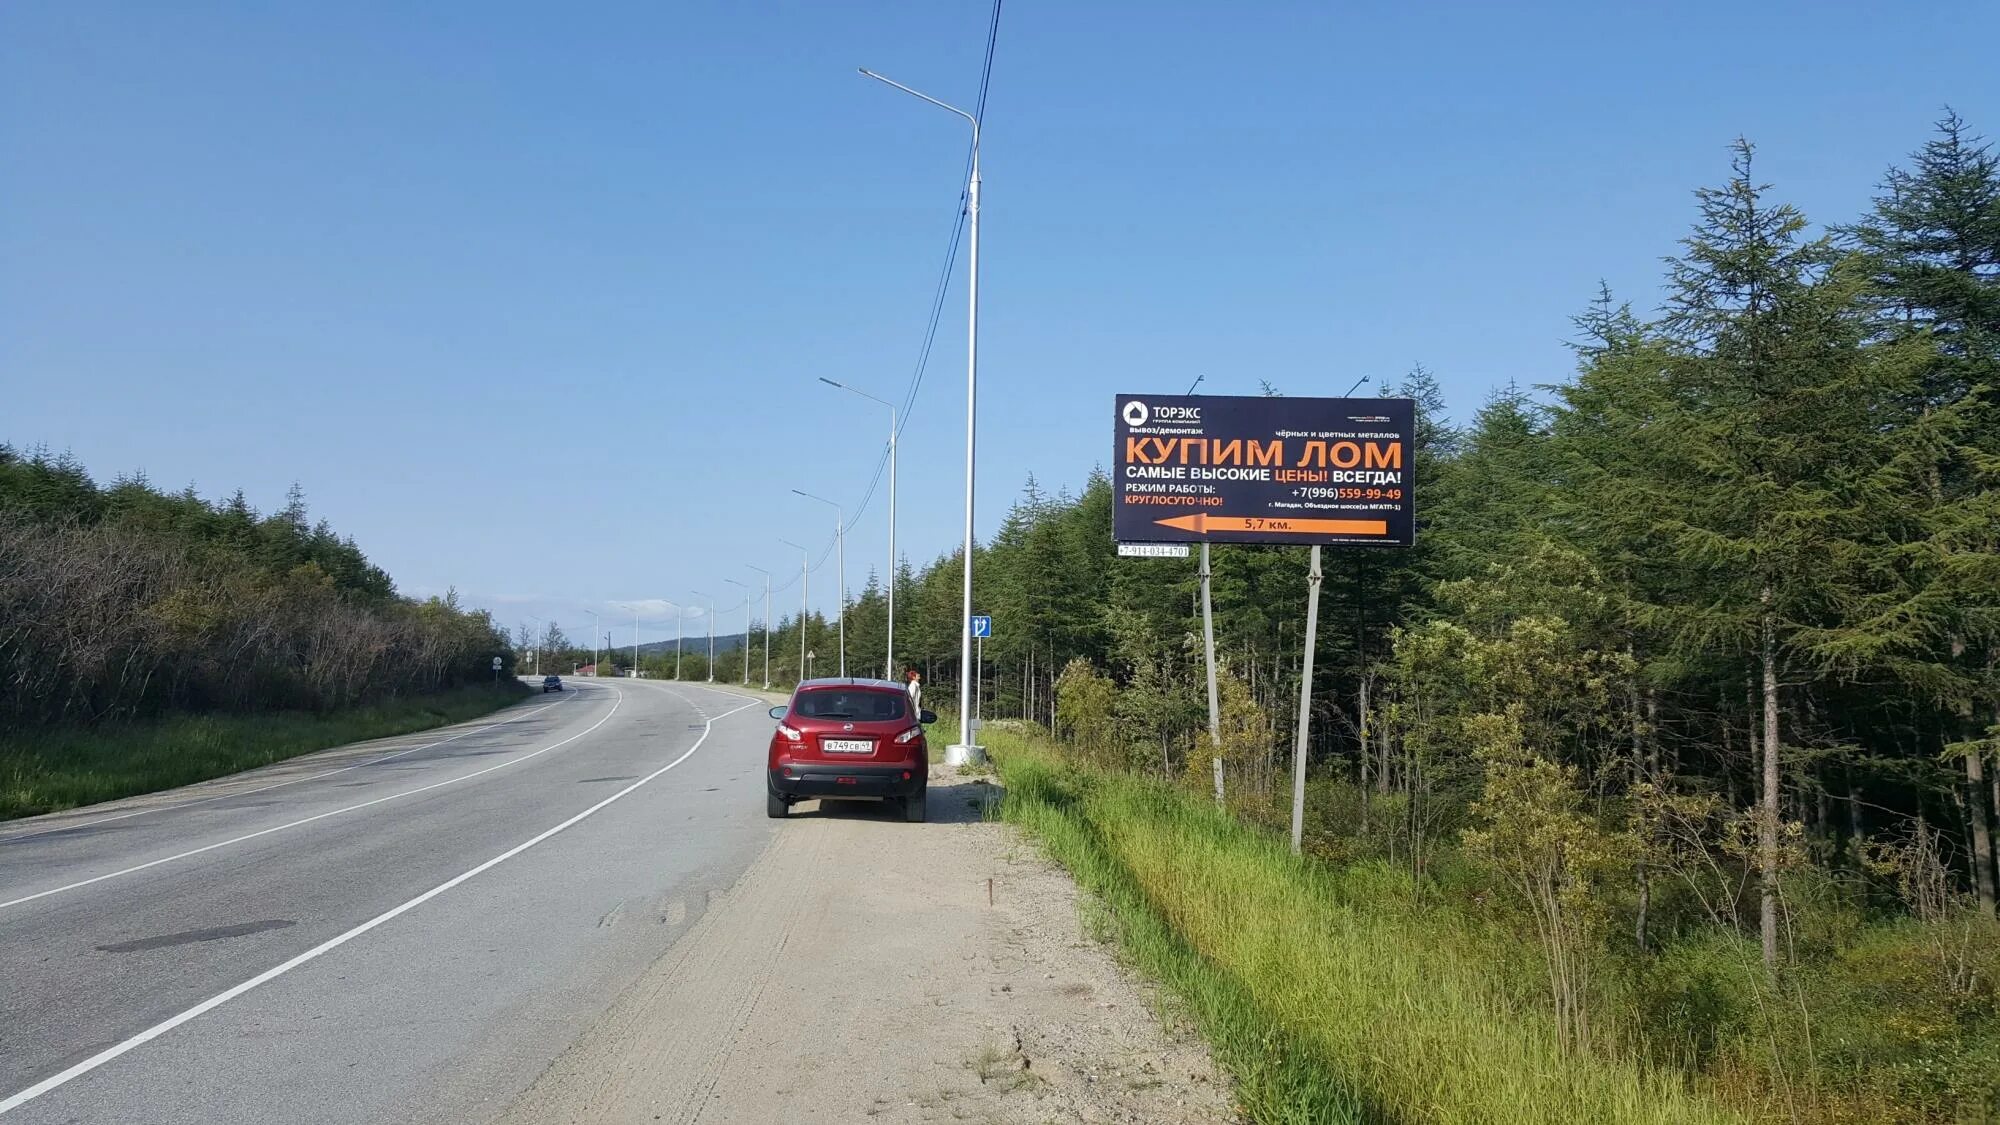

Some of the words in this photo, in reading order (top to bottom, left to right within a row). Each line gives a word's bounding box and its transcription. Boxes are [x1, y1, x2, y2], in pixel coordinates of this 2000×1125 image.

[1153, 407, 1200, 418] ТОРЭКС
[1130, 427, 1203, 435] вывоз/демонтаж
[1276, 430, 1308, 438] чёрных
[1126, 437, 1283, 466] КУПИМ
[1297, 441, 1401, 468] ЛОМ
[1126, 467, 1185, 479] САМЫЕ
[1190, 468, 1270, 480] ВЫСОКИЕ
[1276, 470, 1327, 482] ЦЕНЫ!
[1333, 471, 1401, 485] ВСЕГДА!
[1126, 484, 1165, 492] РЕЖИМ
[1169, 485, 1215, 494] РАБОТЫ:
[1292, 488, 1401, 500] +7(996)559-99-49
[1125, 496, 1223, 506] КРУГЛОСУТОЧНО!
[1244, 519, 1264, 530] 5,7
[1269, 522, 1291, 530] км.
